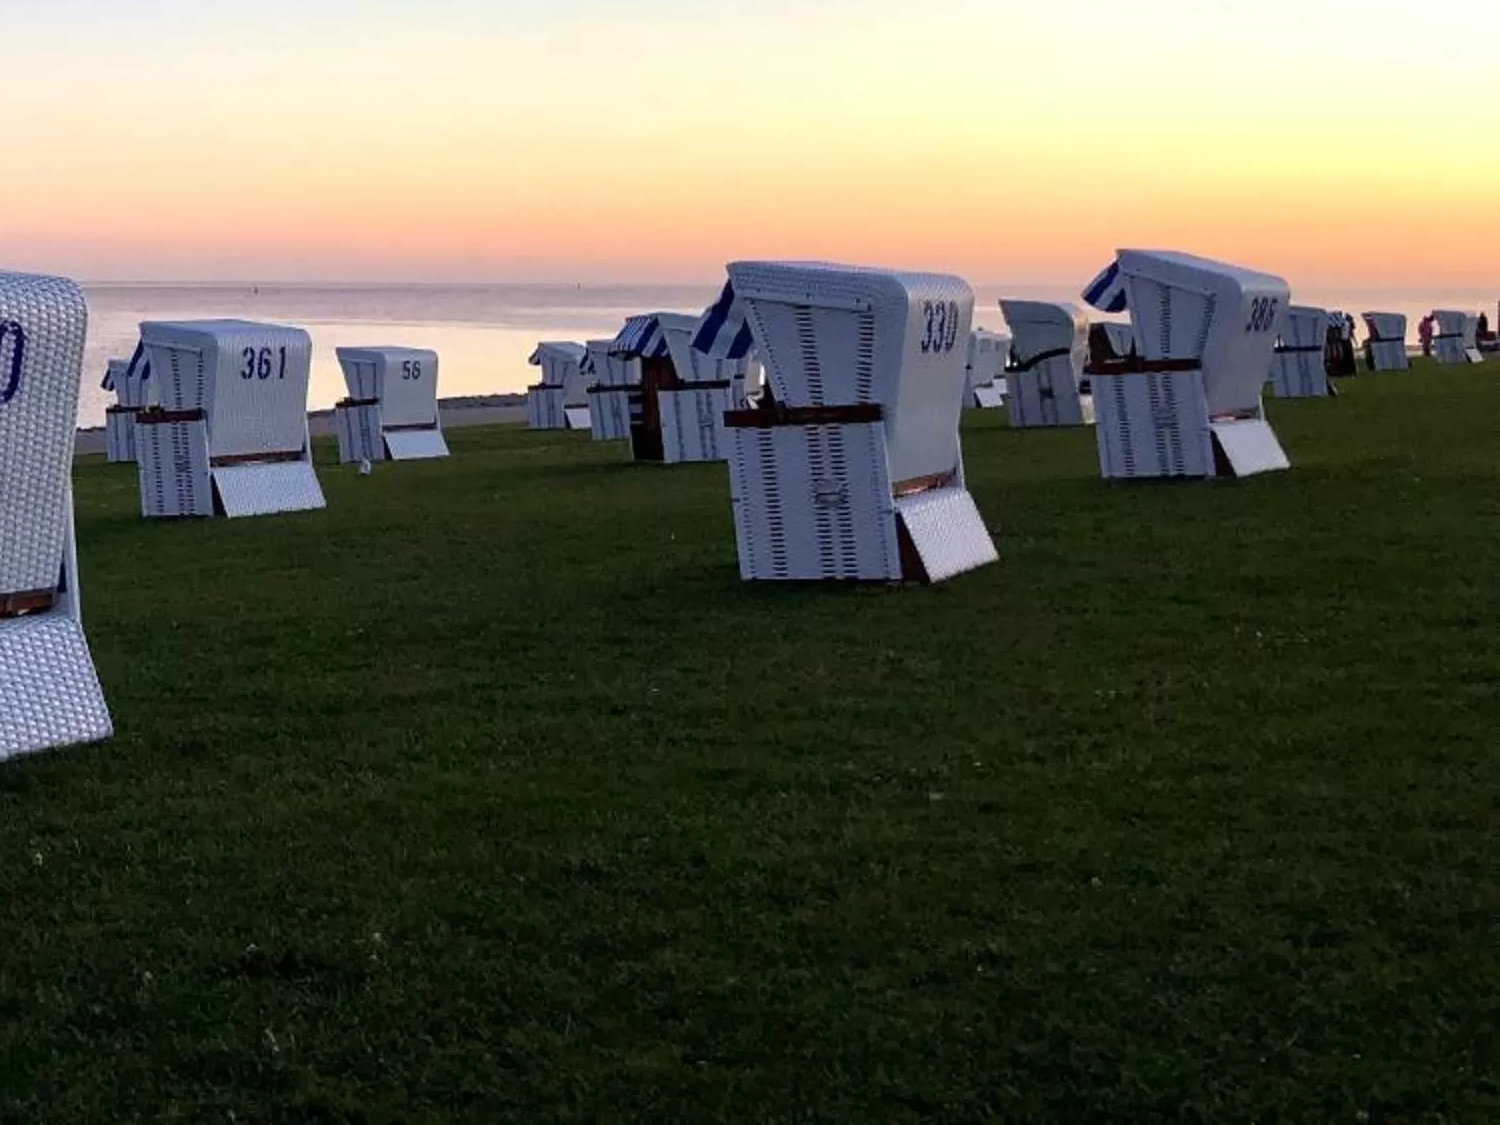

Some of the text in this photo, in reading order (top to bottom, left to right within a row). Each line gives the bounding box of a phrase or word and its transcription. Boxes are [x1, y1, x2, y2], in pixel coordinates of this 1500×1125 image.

[921, 300, 959, 353] 330
[241, 346, 287, 380] 361
[402, 360, 421, 380] 56
